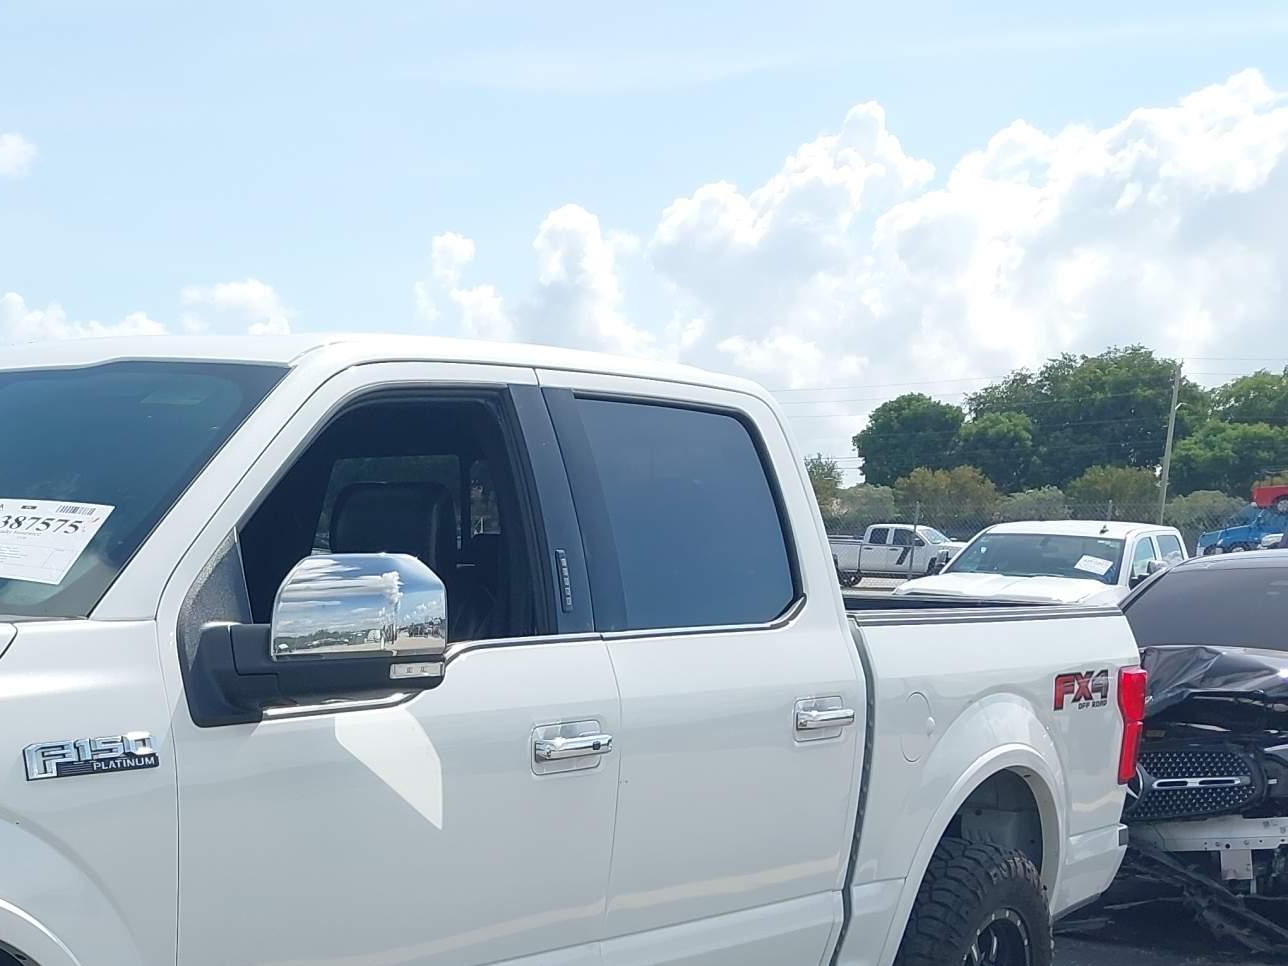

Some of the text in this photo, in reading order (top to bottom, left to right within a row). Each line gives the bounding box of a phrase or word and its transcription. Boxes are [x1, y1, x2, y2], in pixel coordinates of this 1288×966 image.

[1053, 669, 1109, 711] FX4
[1078, 702, 1090, 710] OFF
[93, 757, 155, 770] PLATINUM
